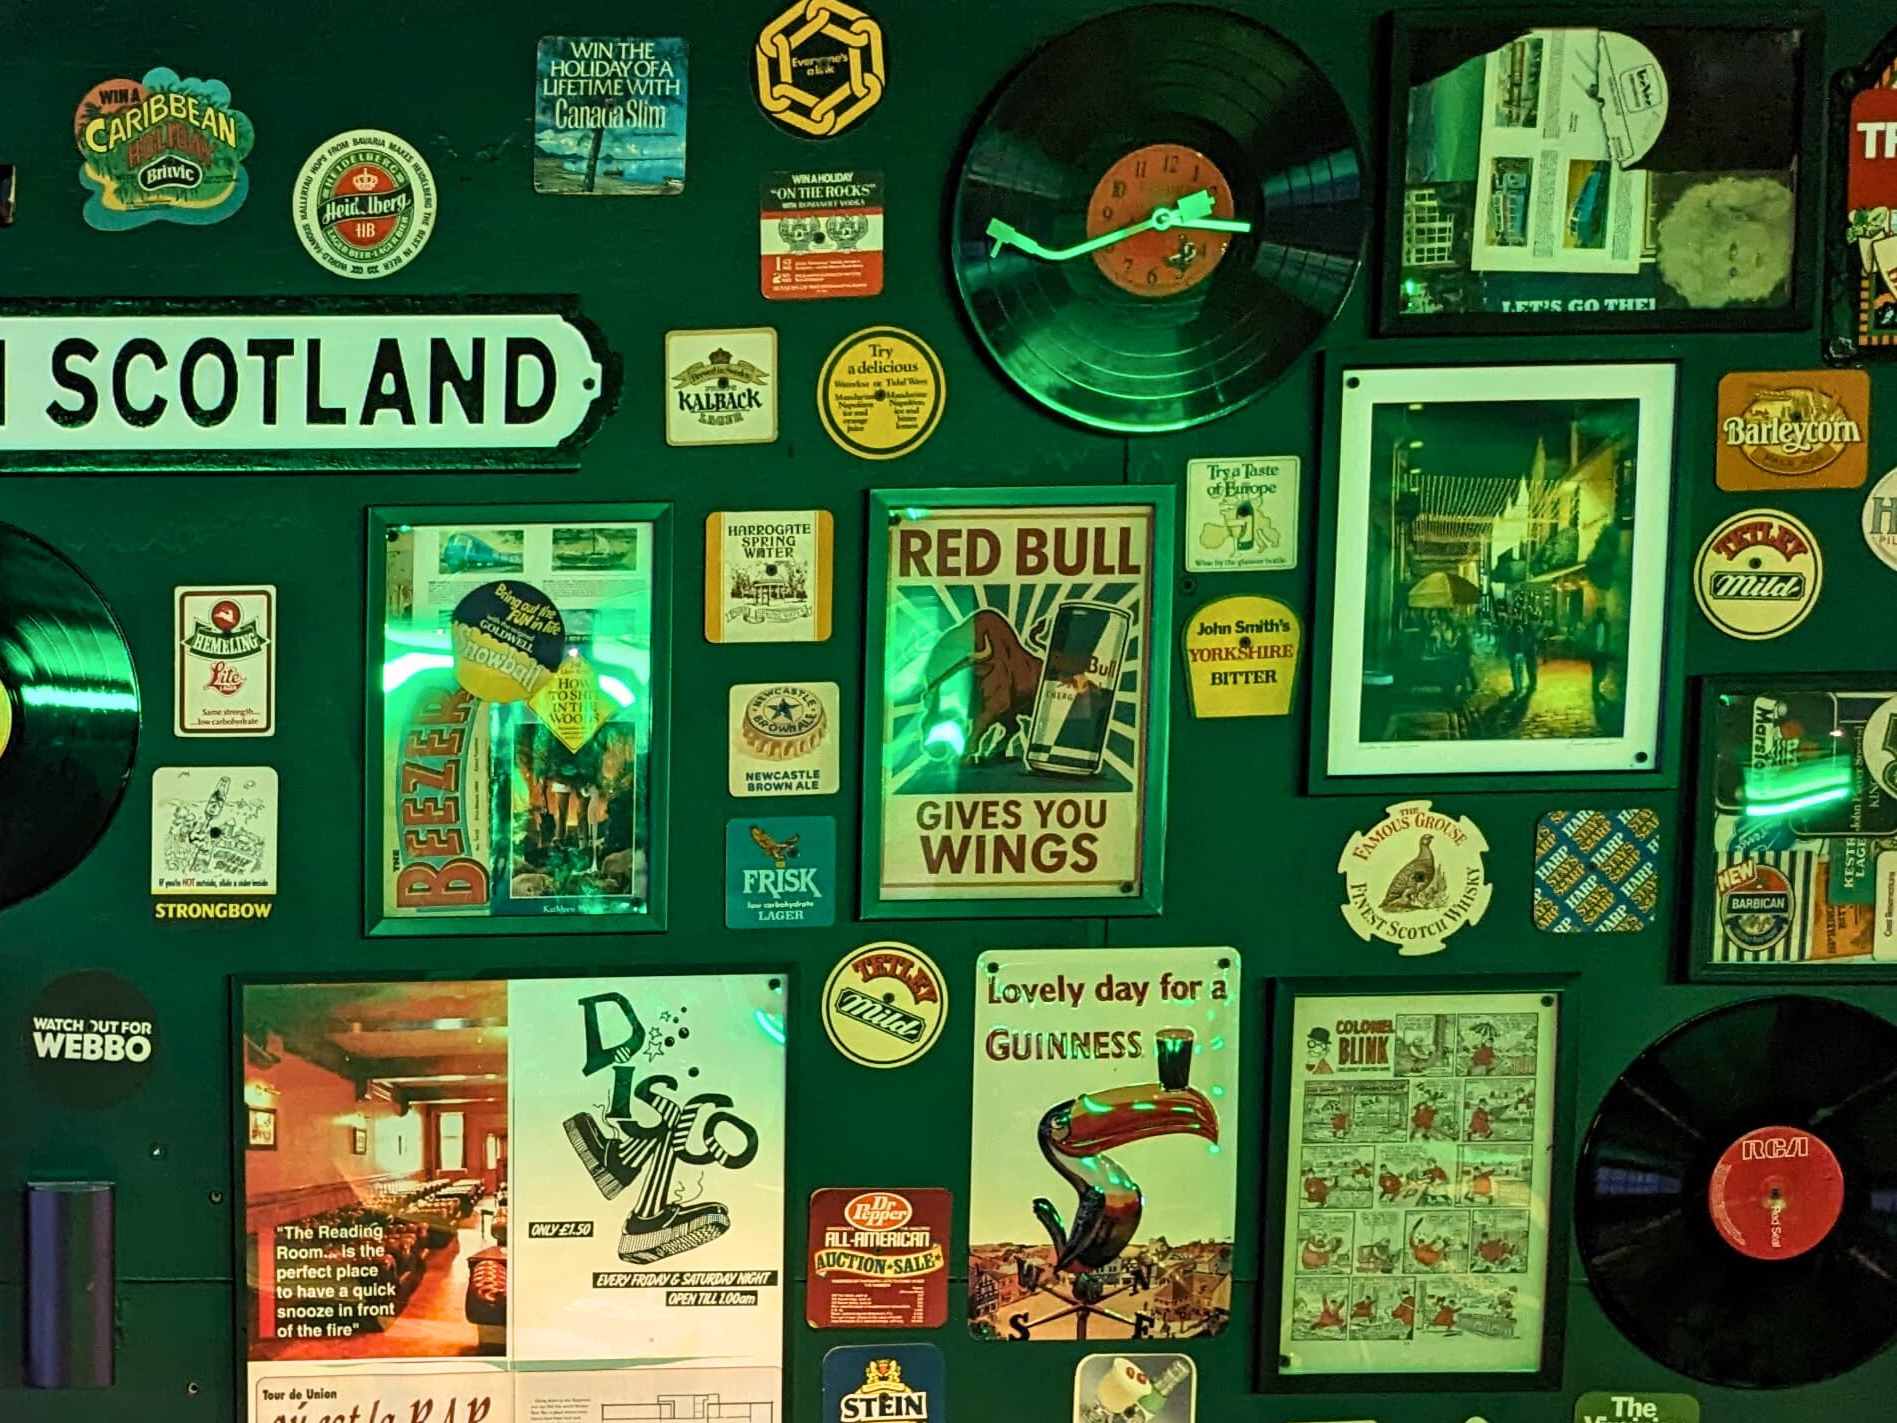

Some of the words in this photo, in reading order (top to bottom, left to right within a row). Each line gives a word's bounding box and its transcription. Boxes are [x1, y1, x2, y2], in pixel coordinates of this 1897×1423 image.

[570, 42, 614, 60] WIN
[617, 42, 655, 60] THE
[550, 60, 633, 78] HOLIDAY
[634, 60, 659, 78] OF
[659, 60, 674, 78] A
[543, 79, 625, 97] LIFETIME
[627, 79, 681, 97] WITH
[84, 91, 237, 153] CARIBBEAN
[555, 98, 625, 130] Canada
[627, 99, 666, 130] Slim
[145, 163, 196, 185] Britvic
[868, 343, 893, 361] Try
[45, 336, 558, 428] SCOTLAND
[677, 387, 764, 411] KALBACK
[1722, 415, 1861, 453] Barleycorn
[727, 523, 813, 538] HARROGATE
[741, 536, 797, 549] SPRING
[1711, 521, 1808, 562] TETLEY
[743, 547, 794, 561] WATER
[899, 528, 1001, 577] RED
[1016, 527, 1142, 576] BULL
[1716, 573, 1801, 597] Mild
[1197, 620, 1232, 637] John
[1235, 618, 1291, 636] Smith's
[191, 630, 259, 656] HEMELING
[1210, 670, 1277, 687] BITTER
[745, 769, 821, 782] NEWCASTLE
[747, 780, 793, 793] BROWN
[795, 779, 820, 792] ALE
[396, 686, 489, 909] BEEZER
[916, 800, 1023, 831] GIVES
[1034, 799, 1108, 829] YOU
[1352, 815, 1411, 862] FAMOUS
[1414, 812, 1468, 846] GROUSE
[919, 832, 1099, 874] WINGS
[742, 868, 823, 900] FRISK
[1717, 860, 1755, 888] NEW
[155, 902, 272, 919] STRONGBOW
[1732, 898, 1786, 910] BARBICAN
[758, 908, 805, 922] LAGER
[853, 953, 939, 1005] TETLEY
[987, 975, 1085, 1005] Lovely
[1095, 975, 1149, 1008] day
[1160, 973, 1201, 1000] for
[1211, 978, 1228, 1000] a
[33, 1017, 84, 1032] WATCH
[121, 1021, 152, 1035] FOR
[837, 990, 923, 1043] Mild
[33, 1031, 152, 1063] WEBBO
[985, 1029, 1144, 1062] GUINNESS
[1337, 1034, 1389, 1066] BLINK
[872, 1196, 897, 1213] Dr
[852, 1202, 910, 1229] Pepper
[277, 1226, 314, 1242] "The
[318, 1224, 384, 1243] Reading
[530, 1222, 560, 1238] ONLY
[561, 1222, 592, 1237] £1.50
[825, 1231, 931, 1248] ALL-AMERICAN
[277, 1245, 339, 1260] Room...
[341, 1244, 355, 1259] is
[359, 1243, 385, 1258] the
[277, 1263, 332, 1282] perfect
[336, 1263, 379, 1281] place
[596, 1273, 630, 1288] EVERY
[631, 1273, 670, 1287] FRIDAY
[670, 1273, 679, 1286] &
[680, 1272, 736, 1287] SATURDAY
[738, 1271, 771, 1286] NIGHT
[277, 1284, 291, 1299] to
[294, 1283, 335, 1299] have
[338, 1287, 349, 1299] a
[352, 1282, 397, 1302] quick
[668, 1292, 695, 1306] OPEN
[696, 1292, 717, 1306] TILL
[277, 1307, 334, 1319] snooze
[338, 1304, 353, 1318] in
[356, 1302, 396, 1318] front
[277, 1322, 293, 1338] of
[295, 1322, 322, 1338] the
[325, 1321, 360, 1337] fire"
[842, 1395, 926, 1420] STEIN
[1611, 1397, 1658, 1419] The
